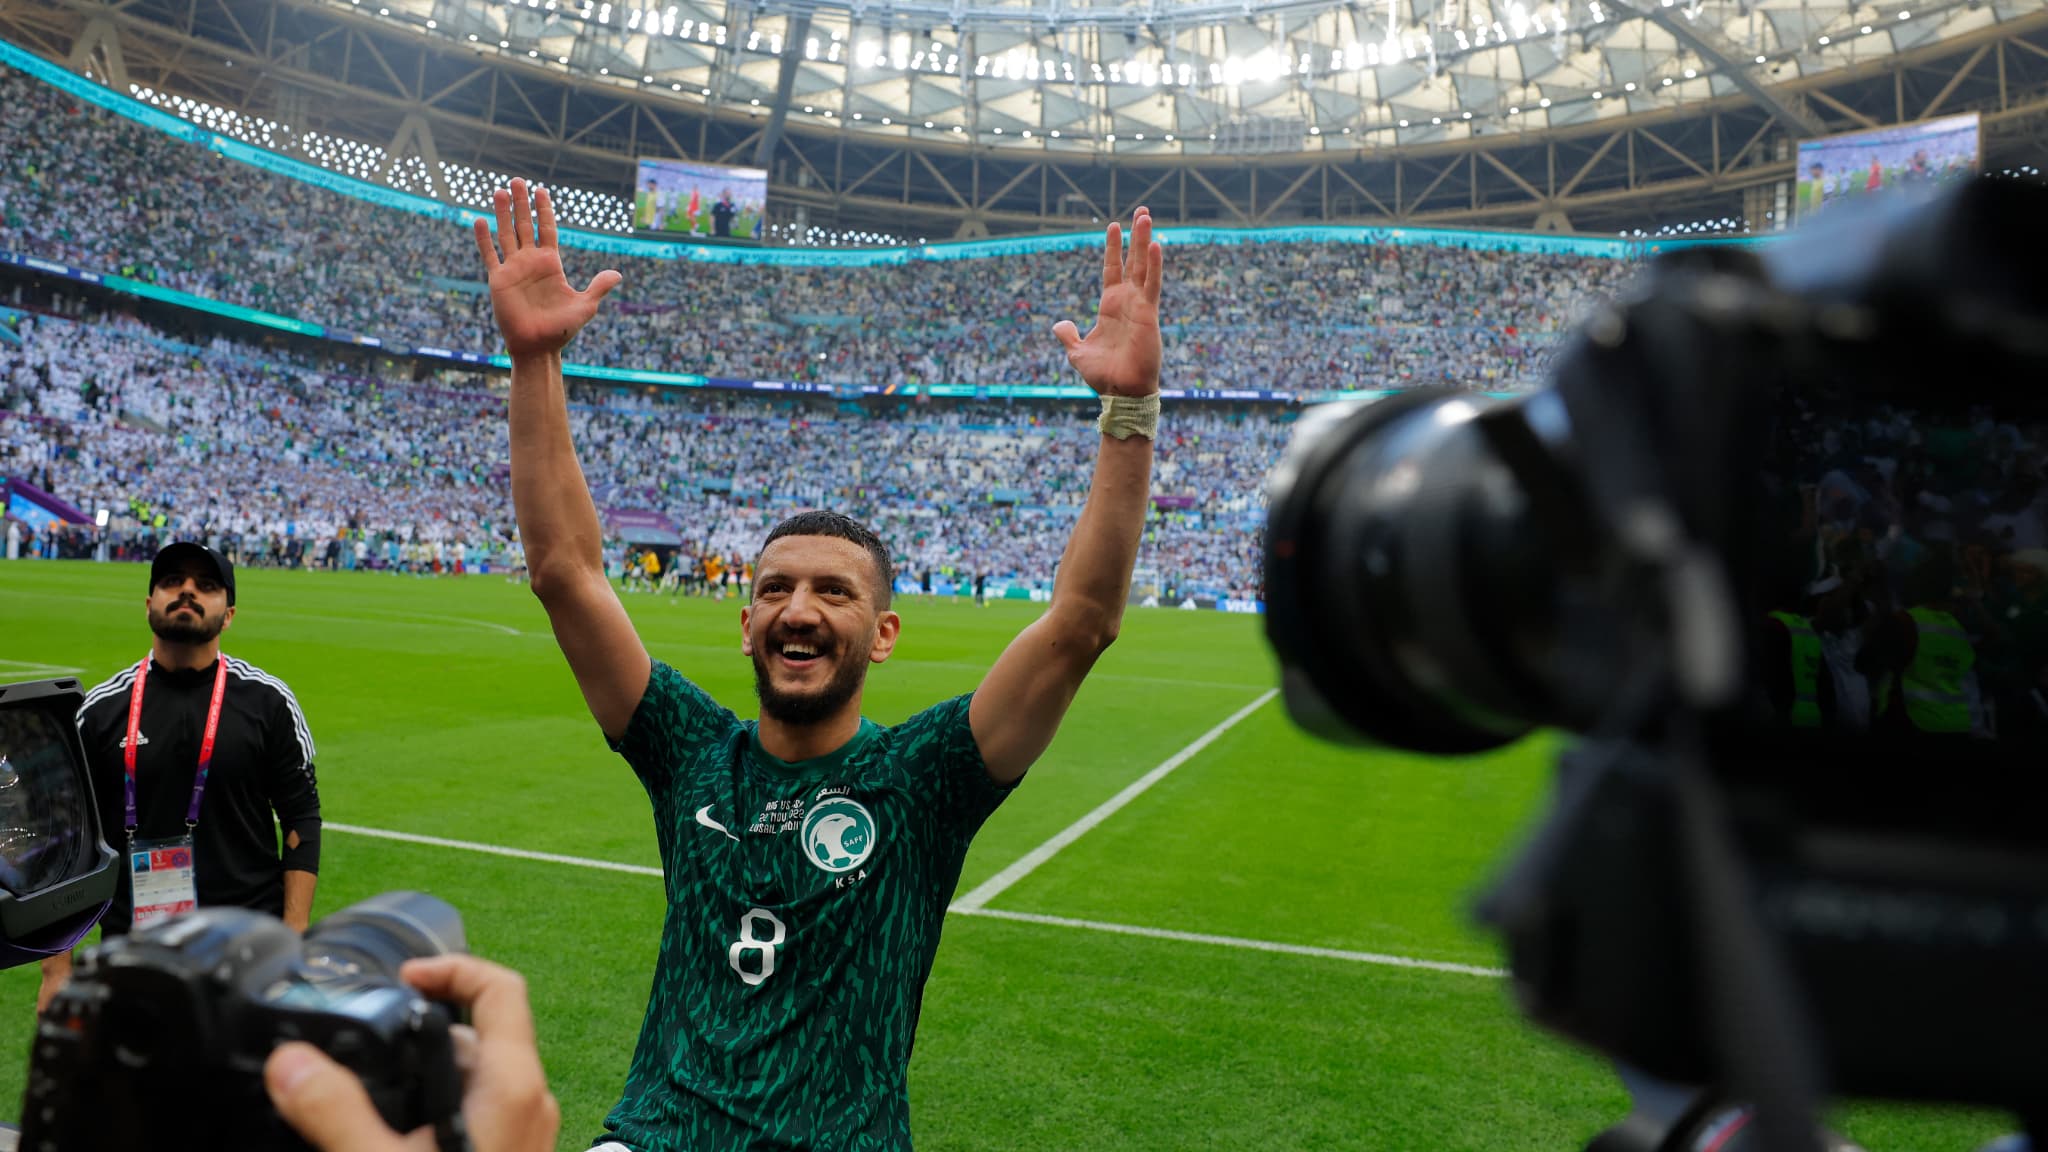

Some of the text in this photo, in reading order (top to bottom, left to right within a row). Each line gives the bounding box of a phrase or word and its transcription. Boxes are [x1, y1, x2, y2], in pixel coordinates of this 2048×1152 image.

[844, 835, 863, 848] SAFF
[835, 869, 867, 888] KSA
[729, 908, 786, 985] 8
